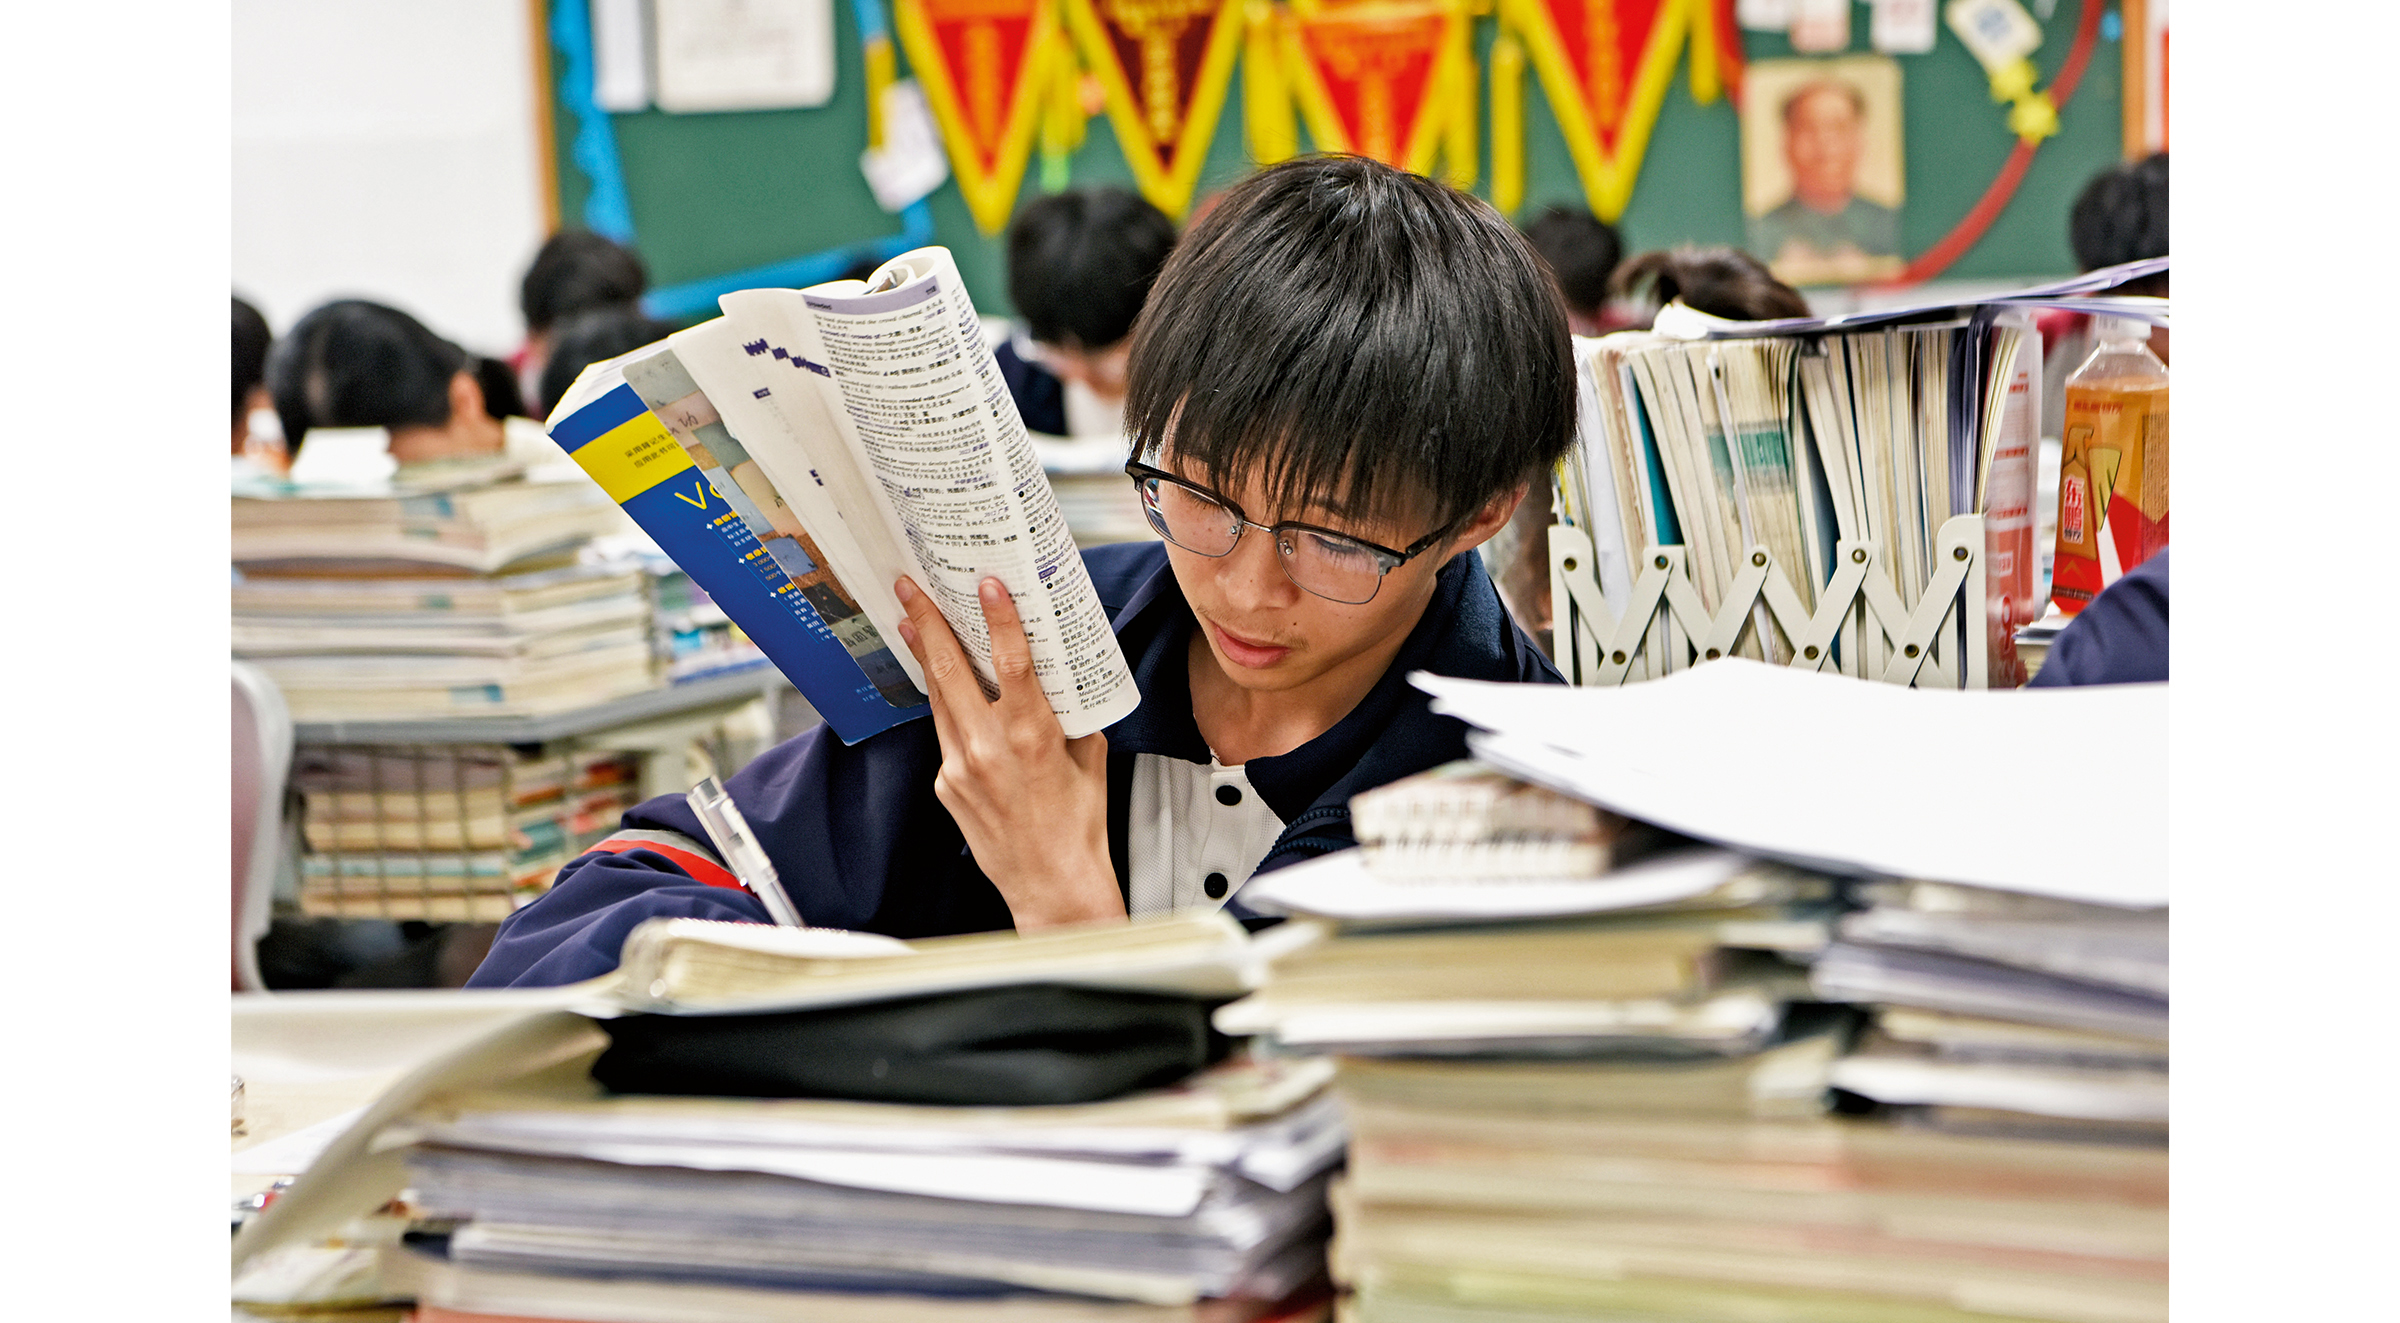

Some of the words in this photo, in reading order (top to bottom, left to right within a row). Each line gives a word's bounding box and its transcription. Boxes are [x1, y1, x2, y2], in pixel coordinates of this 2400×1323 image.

[1034, 555, 1047, 564] cup
[1036, 552, 1065, 570] cupboard
[1060, 590, 1072, 600] could
[1059, 619, 1078, 630] Moving
[1065, 641, 1080, 650] Many
[1083, 660, 1104, 674] complete
[1078, 684, 1100, 698] Medical
